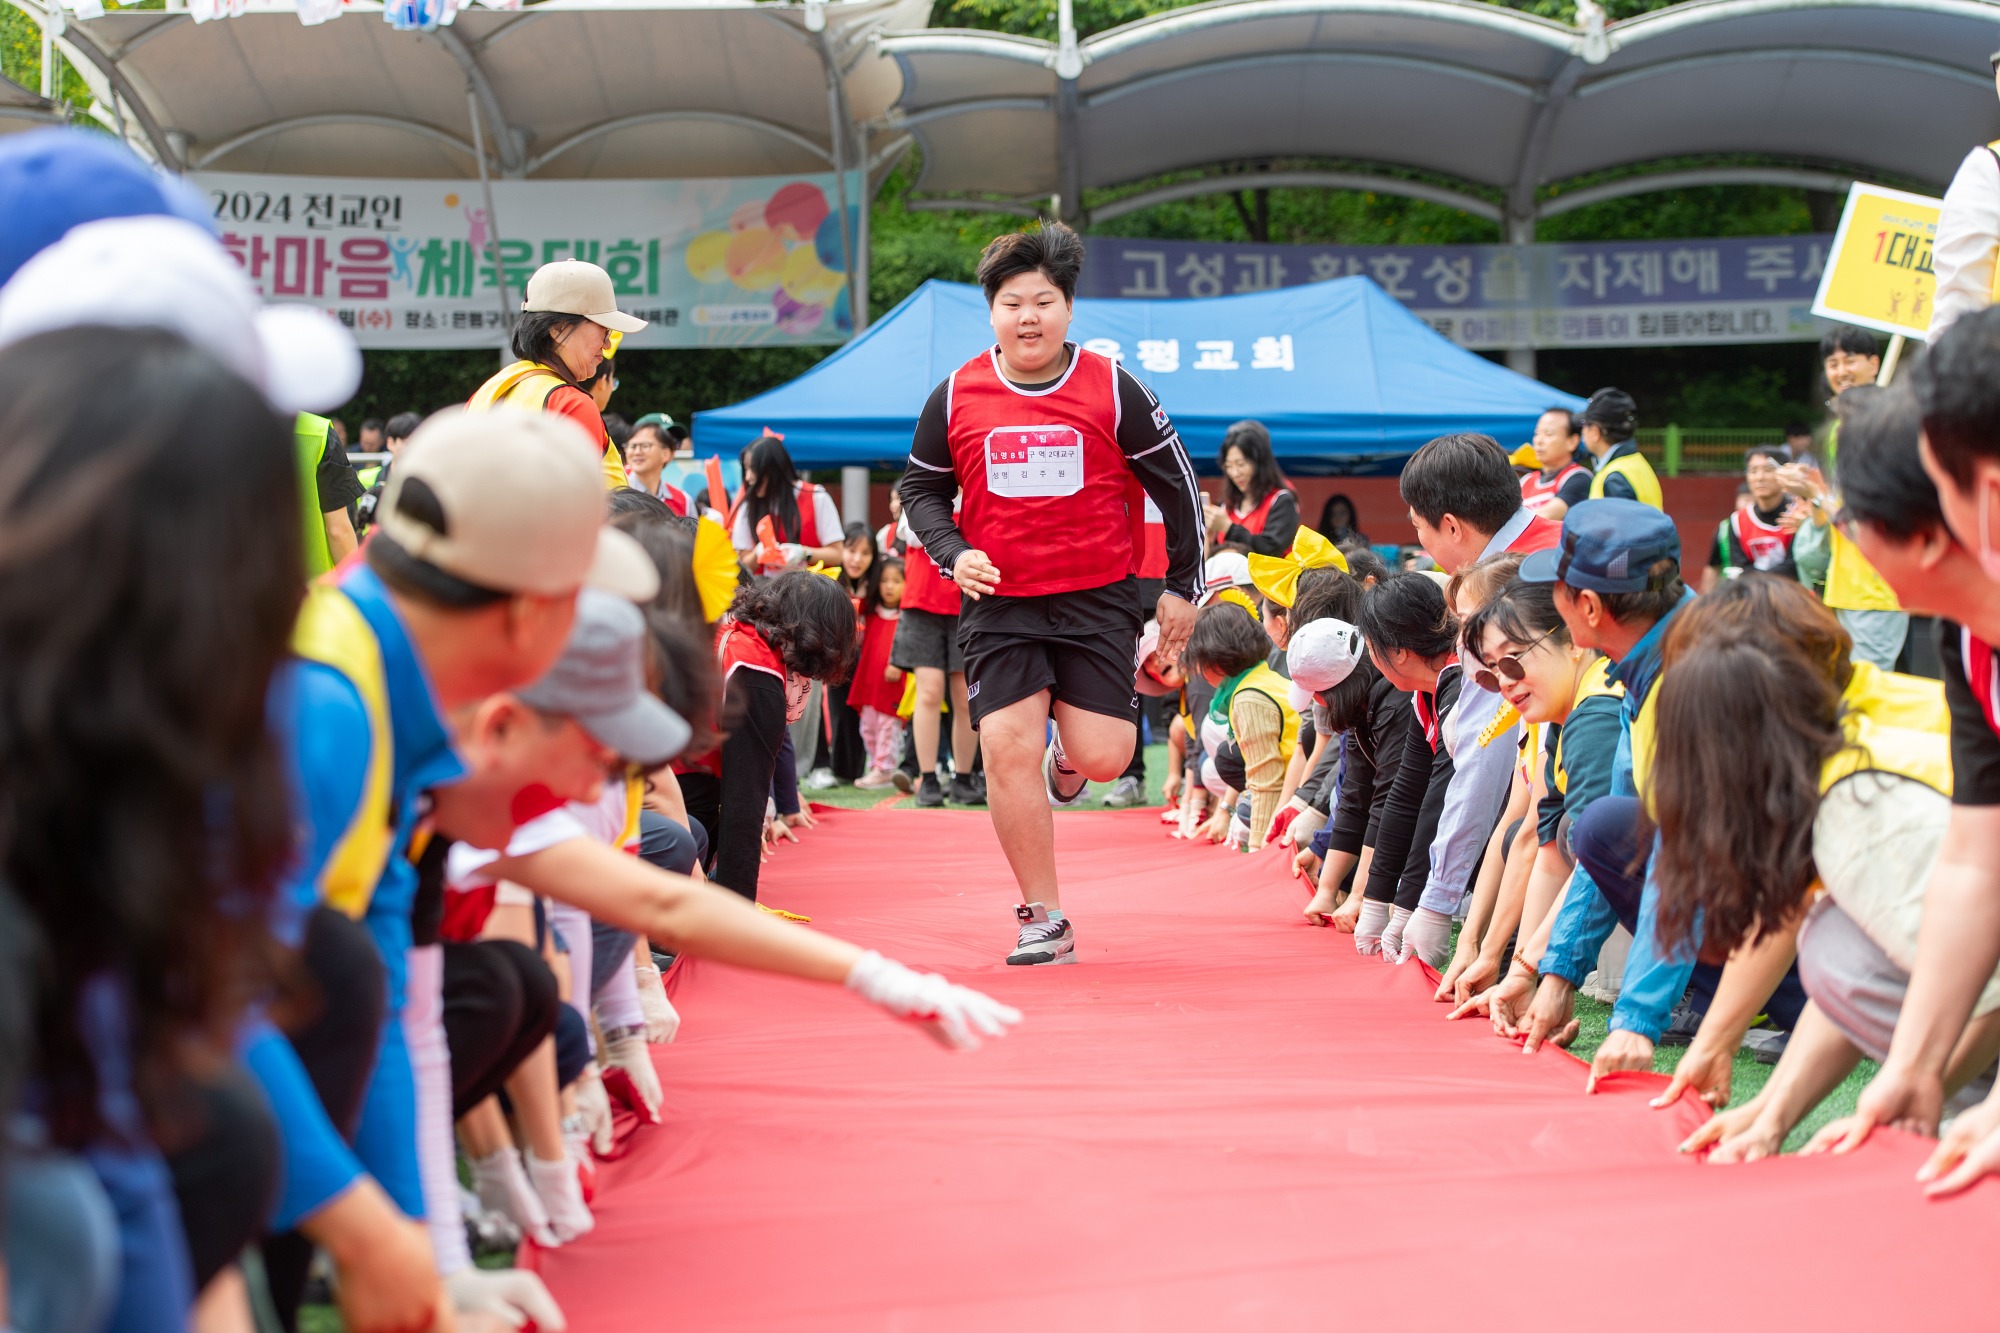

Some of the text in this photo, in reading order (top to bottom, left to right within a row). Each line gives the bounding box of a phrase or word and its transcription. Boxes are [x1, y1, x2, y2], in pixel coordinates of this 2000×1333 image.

[210, 190, 403, 231] 2024 전교인
[1120, 251, 1288, 298] 고성과
[1557, 247, 1721, 298] 자제해
[1048, 450, 1075, 458] 2대교구
